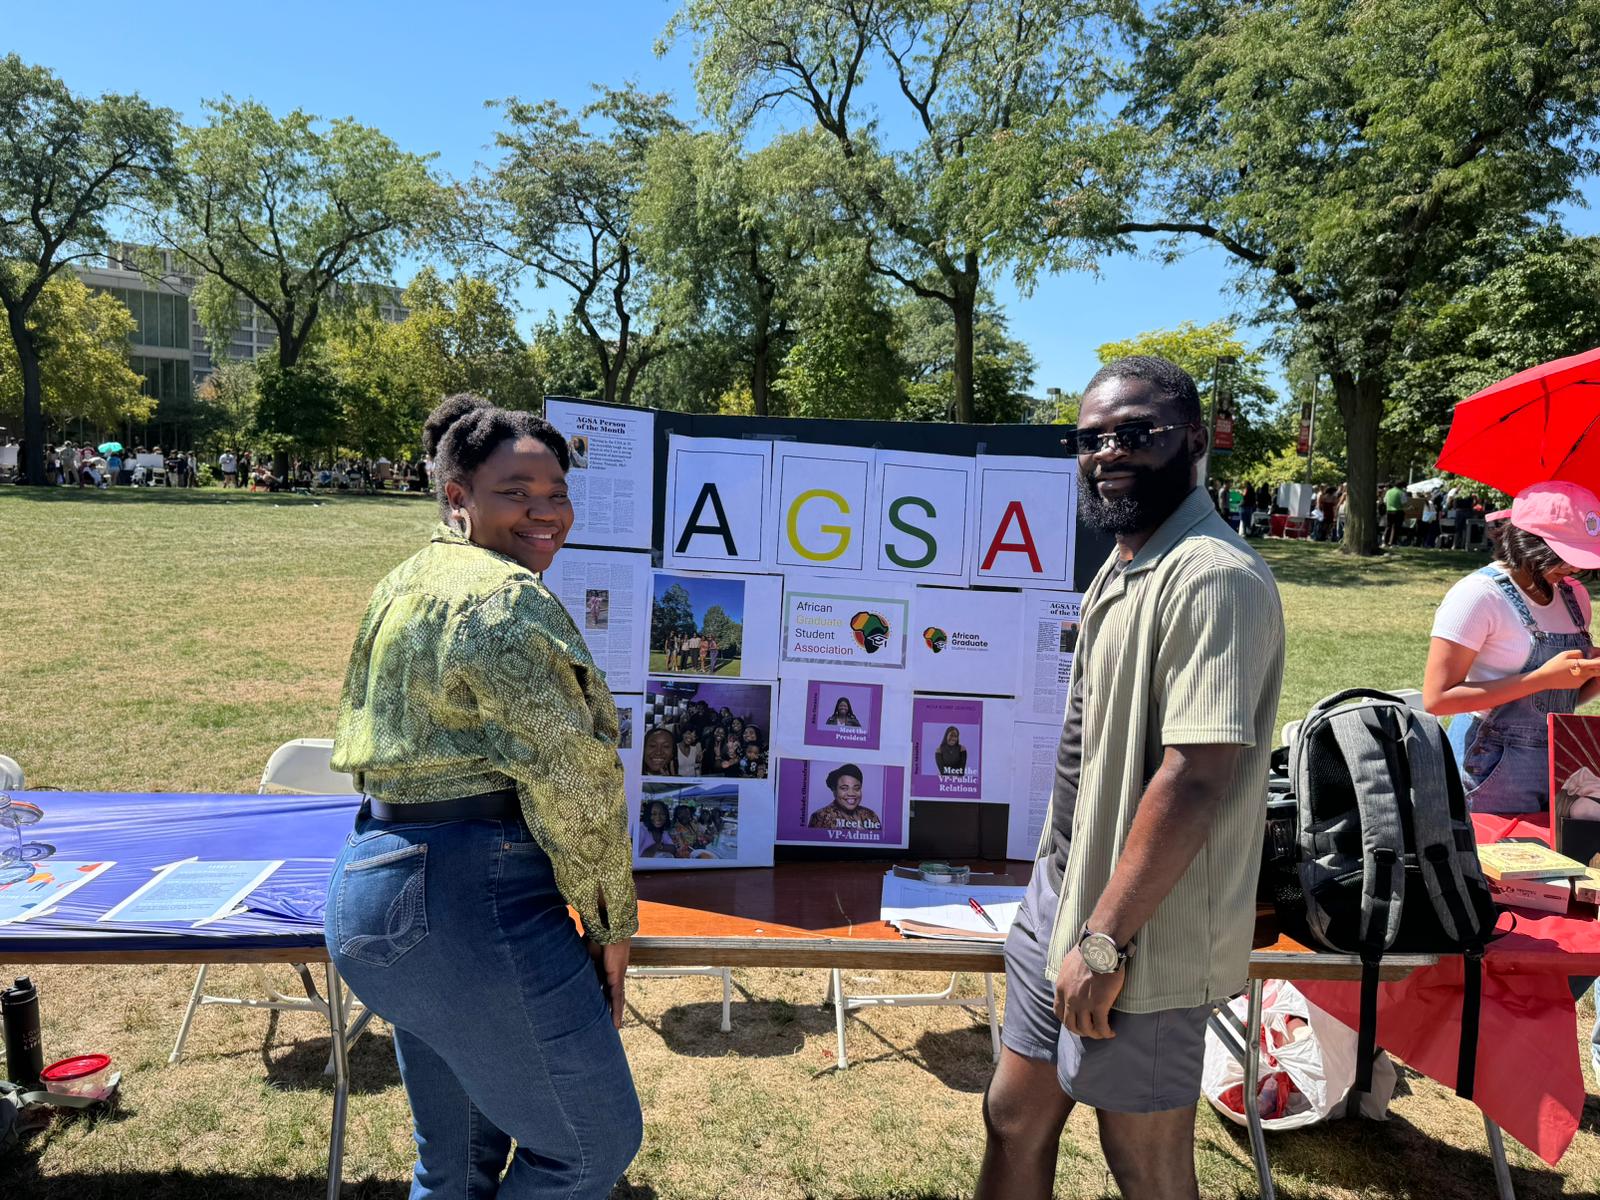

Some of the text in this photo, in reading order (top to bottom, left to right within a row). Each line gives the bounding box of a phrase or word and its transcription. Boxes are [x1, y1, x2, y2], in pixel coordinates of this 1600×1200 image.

[576, 417, 626, 428] AGSA Person
[600, 426, 626, 434] Month
[797, 601, 833, 613] African
[796, 615, 842, 627] Graduate
[795, 628, 836, 640] Student
[952, 632, 980, 640] African
[951, 639, 988, 648] Graduate
[794, 643, 854, 656] Association
[856, 727, 867, 735] the
[835, 733, 867, 742] President
[943, 766, 977, 774] Meet the
[939, 775, 977, 784] VP-Public
[939, 784, 977, 793] Relations
[836, 819, 881, 829] Meet the
[827, 830, 880, 840] VP-Admin
